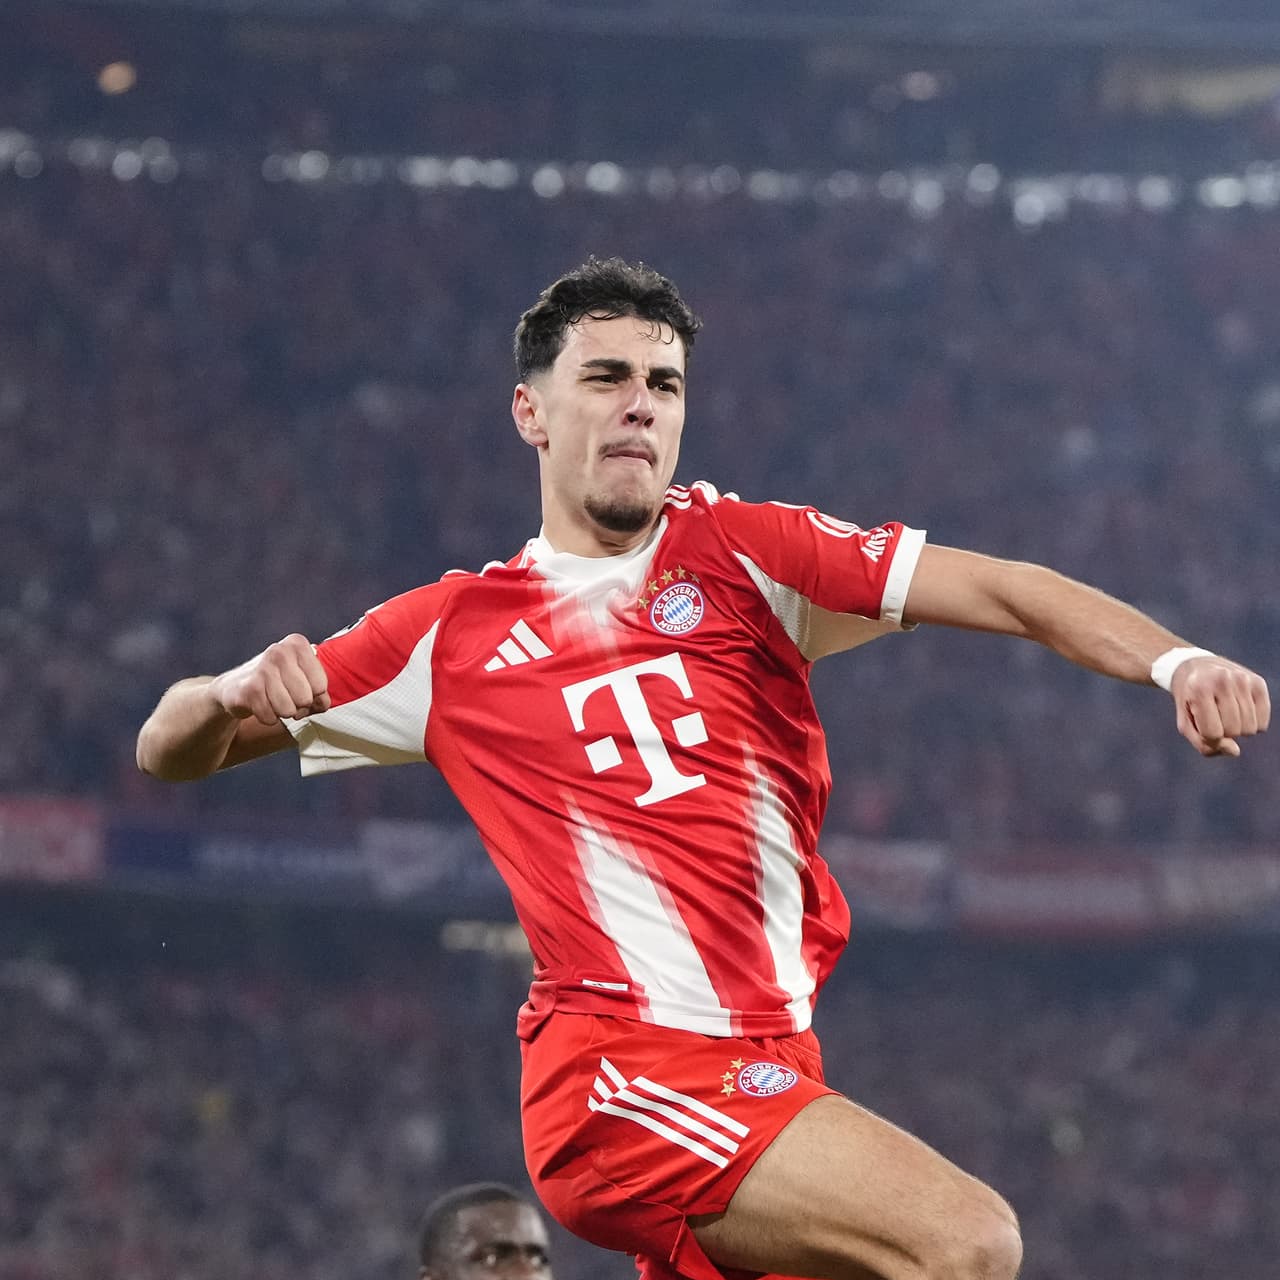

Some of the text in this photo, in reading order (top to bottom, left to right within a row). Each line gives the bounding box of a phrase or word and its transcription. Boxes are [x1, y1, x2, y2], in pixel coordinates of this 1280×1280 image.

[654, 586, 698, 615] FC BAYERN
[742, 1078, 754, 1089] FC
